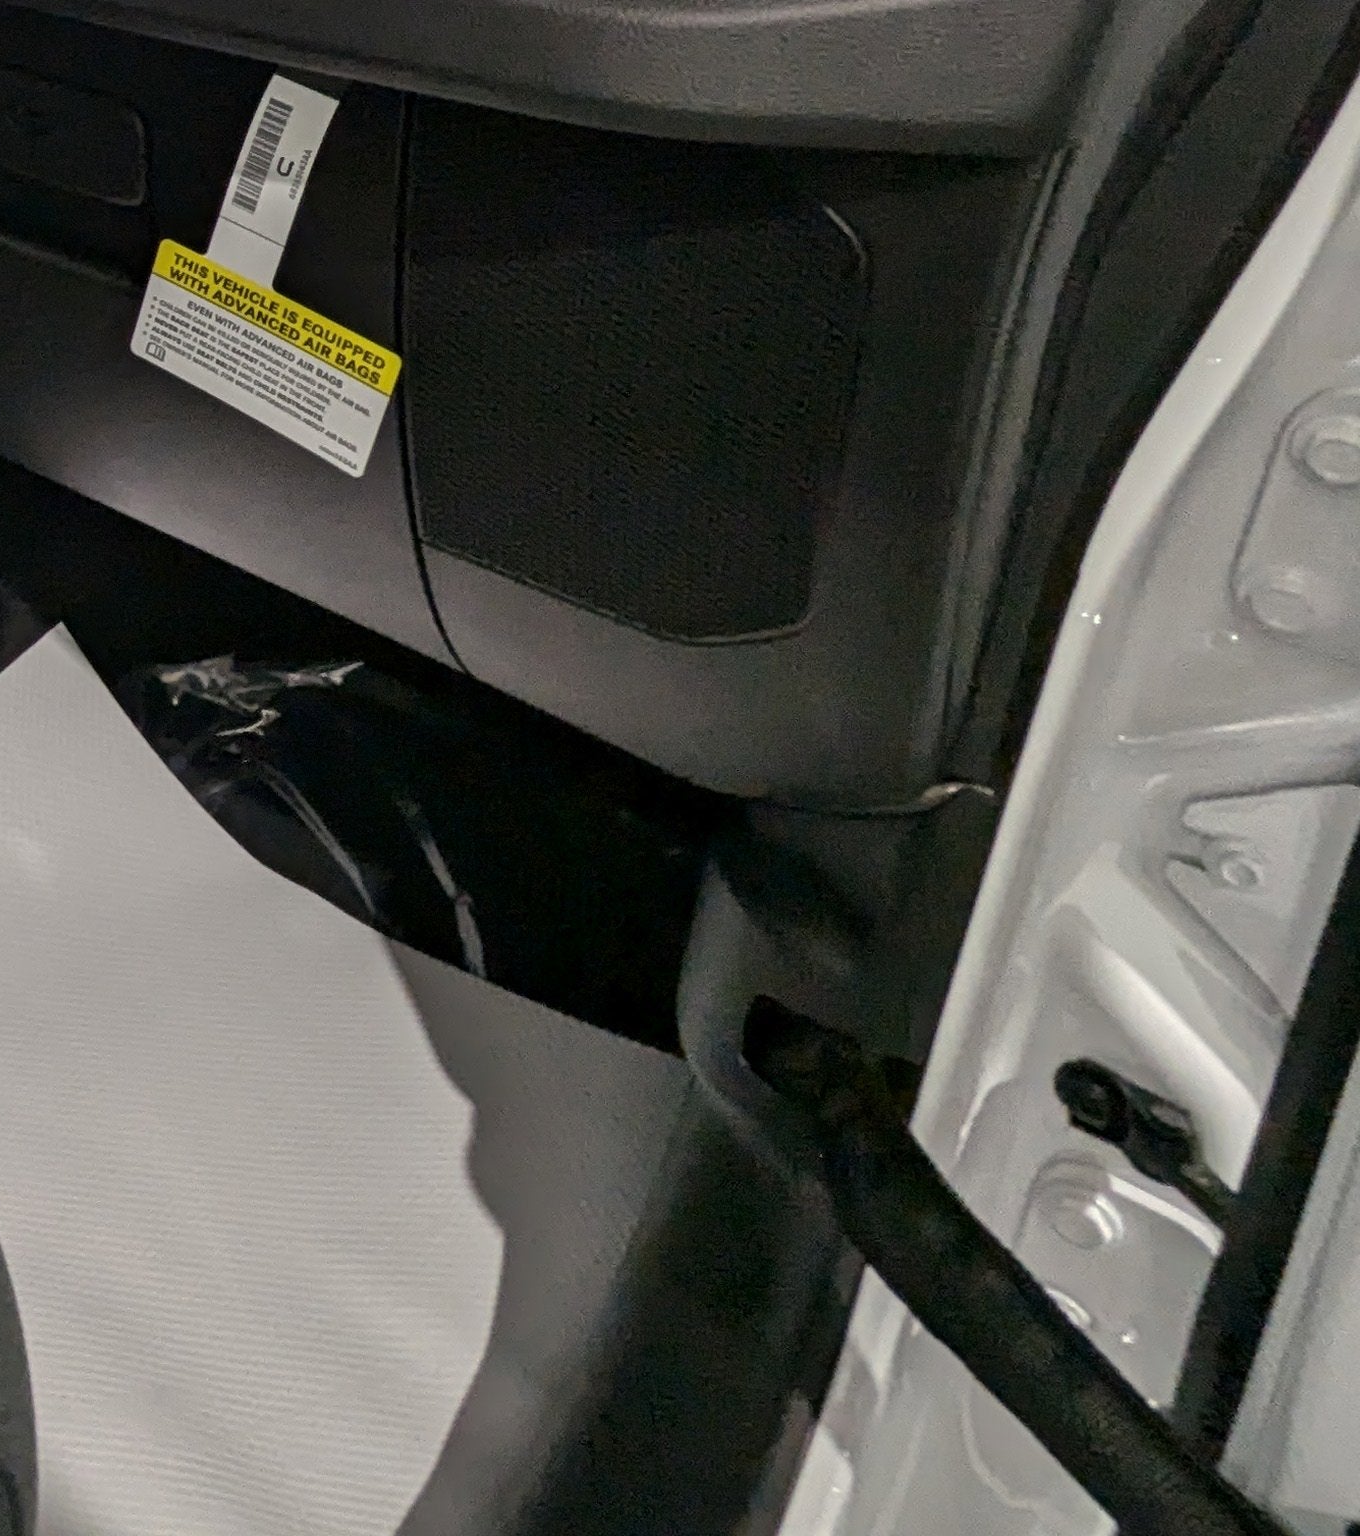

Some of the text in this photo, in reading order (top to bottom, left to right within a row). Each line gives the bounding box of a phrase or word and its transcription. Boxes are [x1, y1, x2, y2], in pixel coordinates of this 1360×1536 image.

[168, 266, 380, 385] WITH ADVANCED AIR BAGS
[172, 252, 386, 371] THIS VEHICLE IS EQUIPPED
[187, 300, 344, 389] EVEN WITH ADVANCED AIR BAGS
